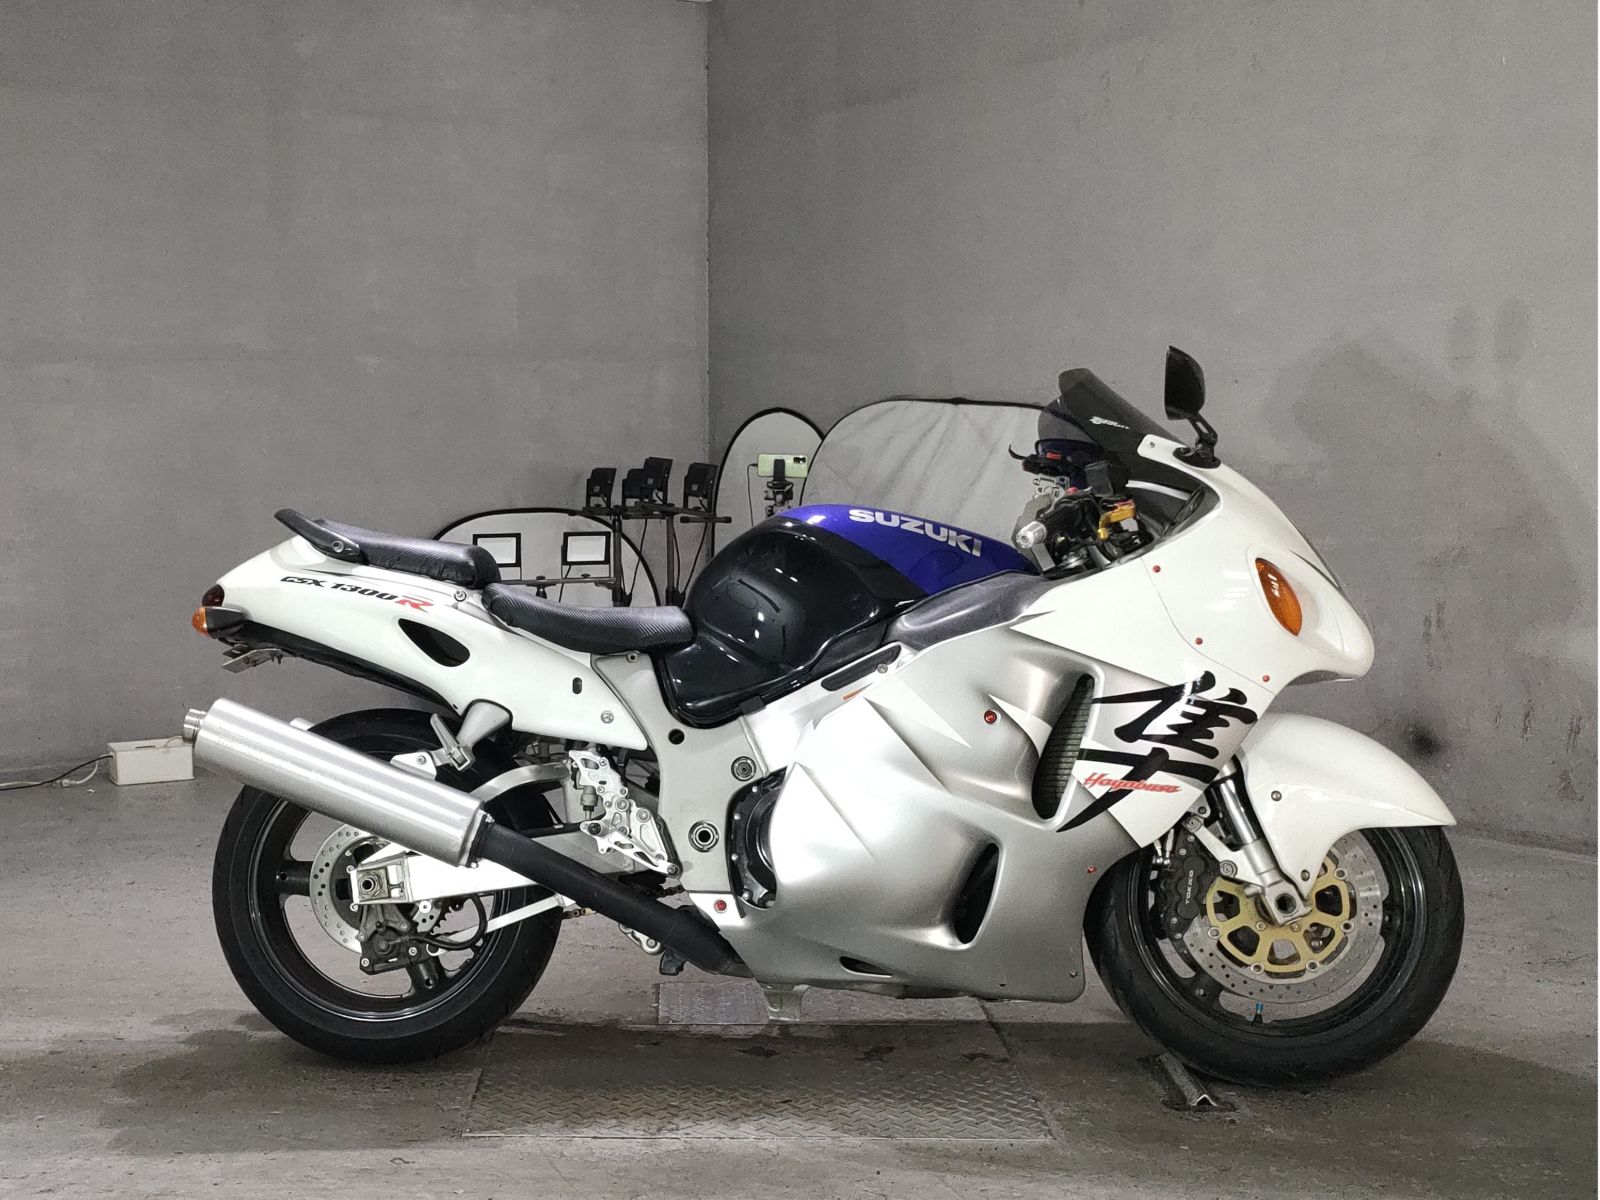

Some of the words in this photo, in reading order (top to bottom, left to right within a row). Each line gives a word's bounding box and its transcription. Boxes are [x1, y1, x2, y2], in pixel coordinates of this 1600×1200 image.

[848, 508, 982, 558] SUZUKI
[280, 576, 328, 588] GSX
[1056, 670, 1258, 833] 隼
[1083, 772, 1182, 793] Hayabusa
